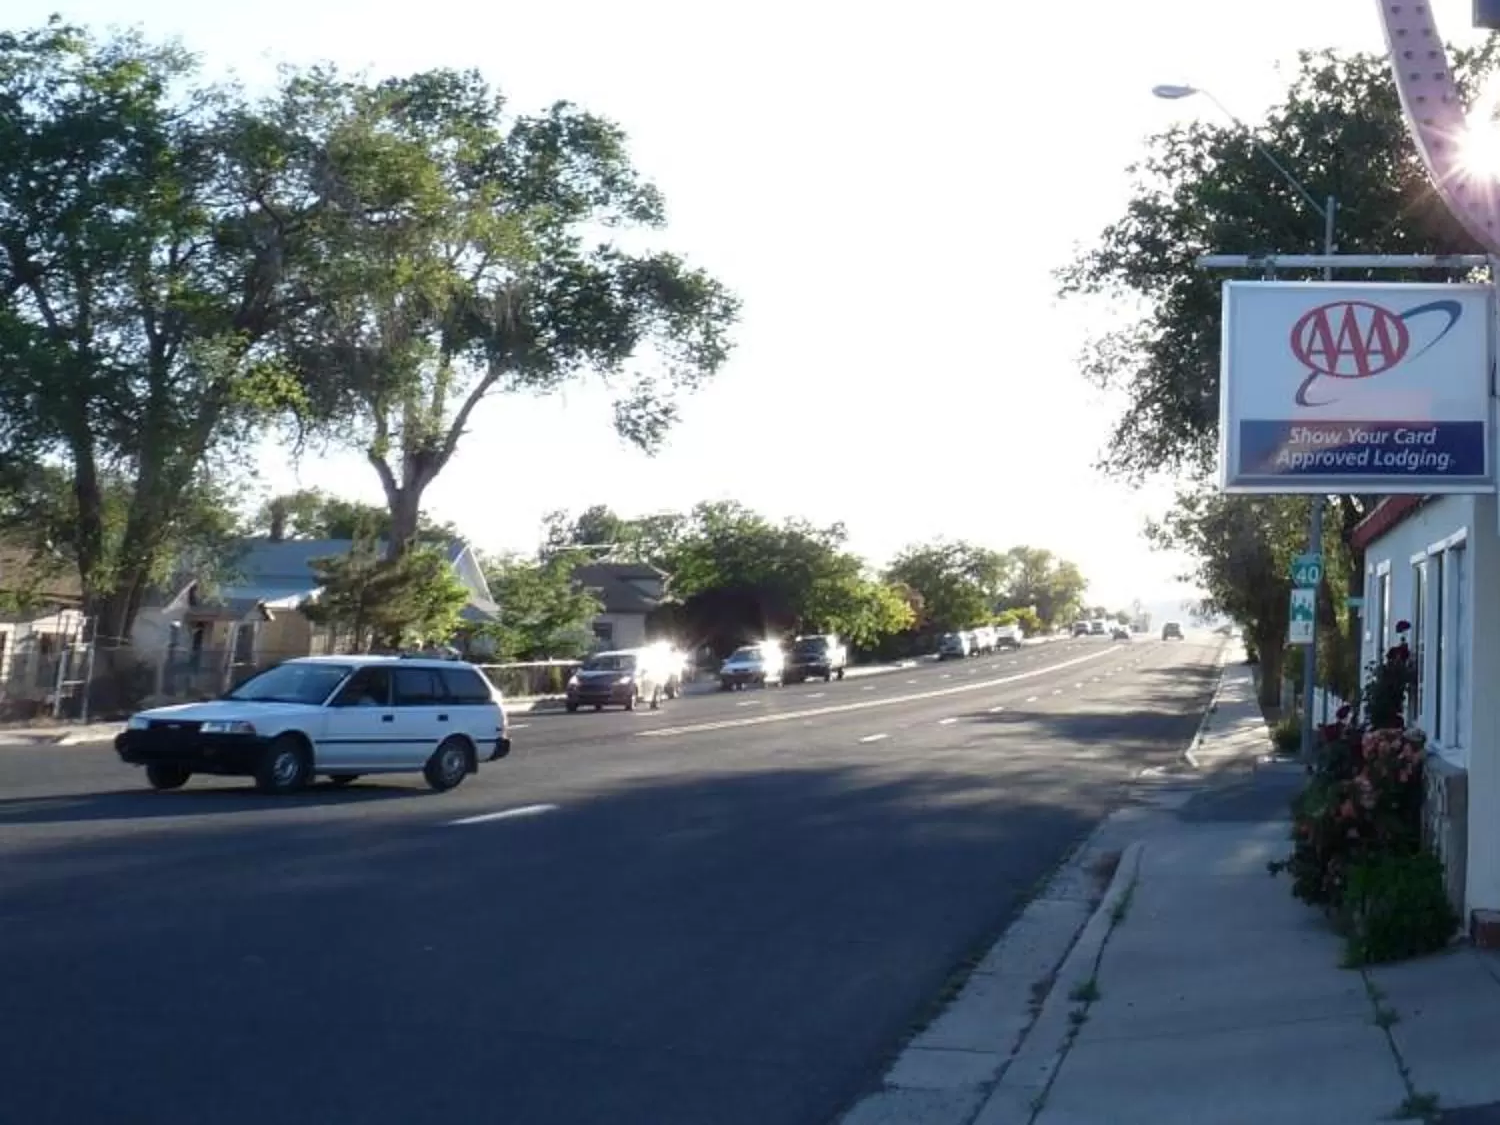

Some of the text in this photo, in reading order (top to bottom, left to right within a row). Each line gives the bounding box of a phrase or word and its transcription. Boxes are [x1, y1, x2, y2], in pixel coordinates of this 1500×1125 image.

[1305, 303, 1398, 377] AAA
[1288, 427, 1438, 444] Show Your Card
[1276, 447, 1450, 471] Approved Lodging
[1295, 565, 1320, 584] 40
